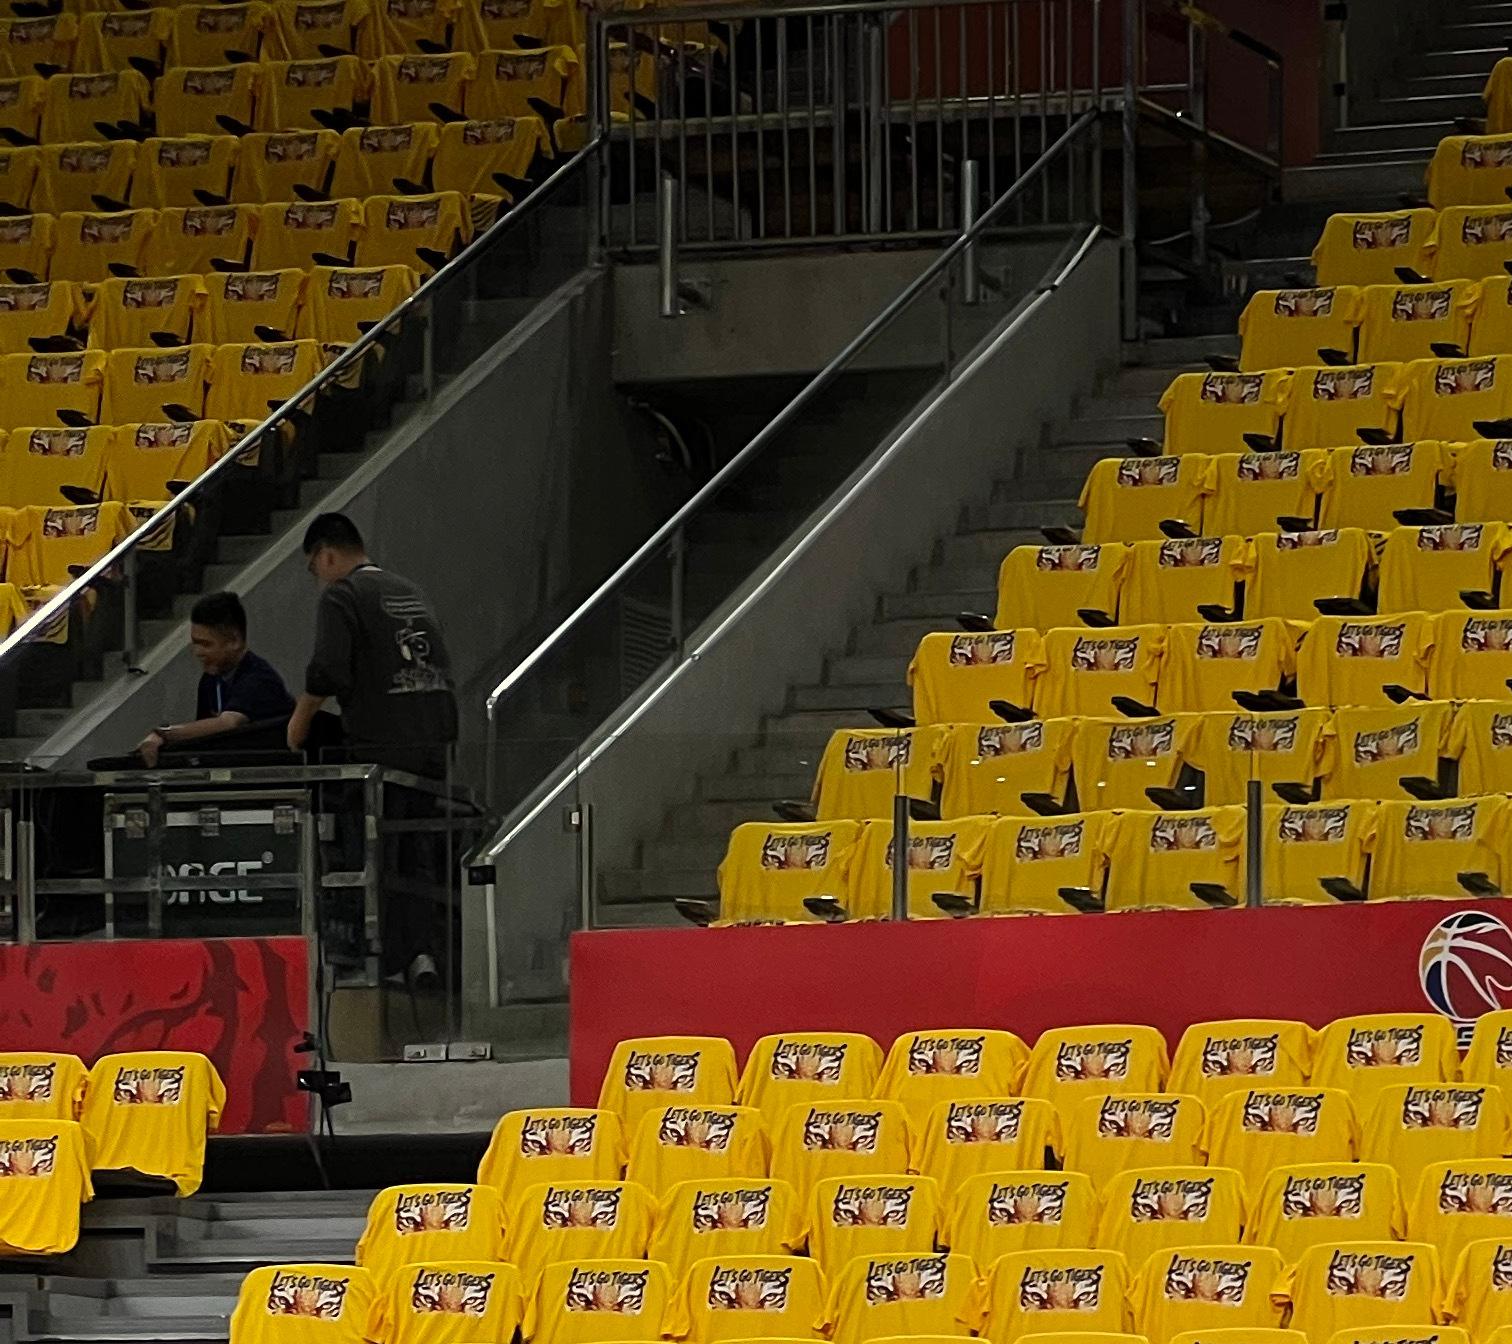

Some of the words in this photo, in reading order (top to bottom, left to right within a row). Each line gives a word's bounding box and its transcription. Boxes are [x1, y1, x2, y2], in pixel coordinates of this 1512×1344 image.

[1202, 1037, 1228, 1055] LET'S
[1229, 1037, 1242, 1050] GO
[1243, 1034, 1279, 1053] TIGERS
[114, 1067, 139, 1084] LET'S
[139, 1068, 151, 1080] GO
[152, 1065, 185, 1084] TIGERS
[804, 1108, 832, 1126] LET'S
[831, 1111, 845, 1124] GO
[846, 1111, 882, 1130] TIGERS
[1131, 1178, 1160, 1197] LET'S
[1160, 1180, 1174, 1193] GO
[1175, 1177, 1214, 1198] TIGERS
[1328, 1249, 1358, 1269] LET'S
[1358, 1254, 1373, 1268] GO
[1374, 1255, 1414, 1275] TIGERS
